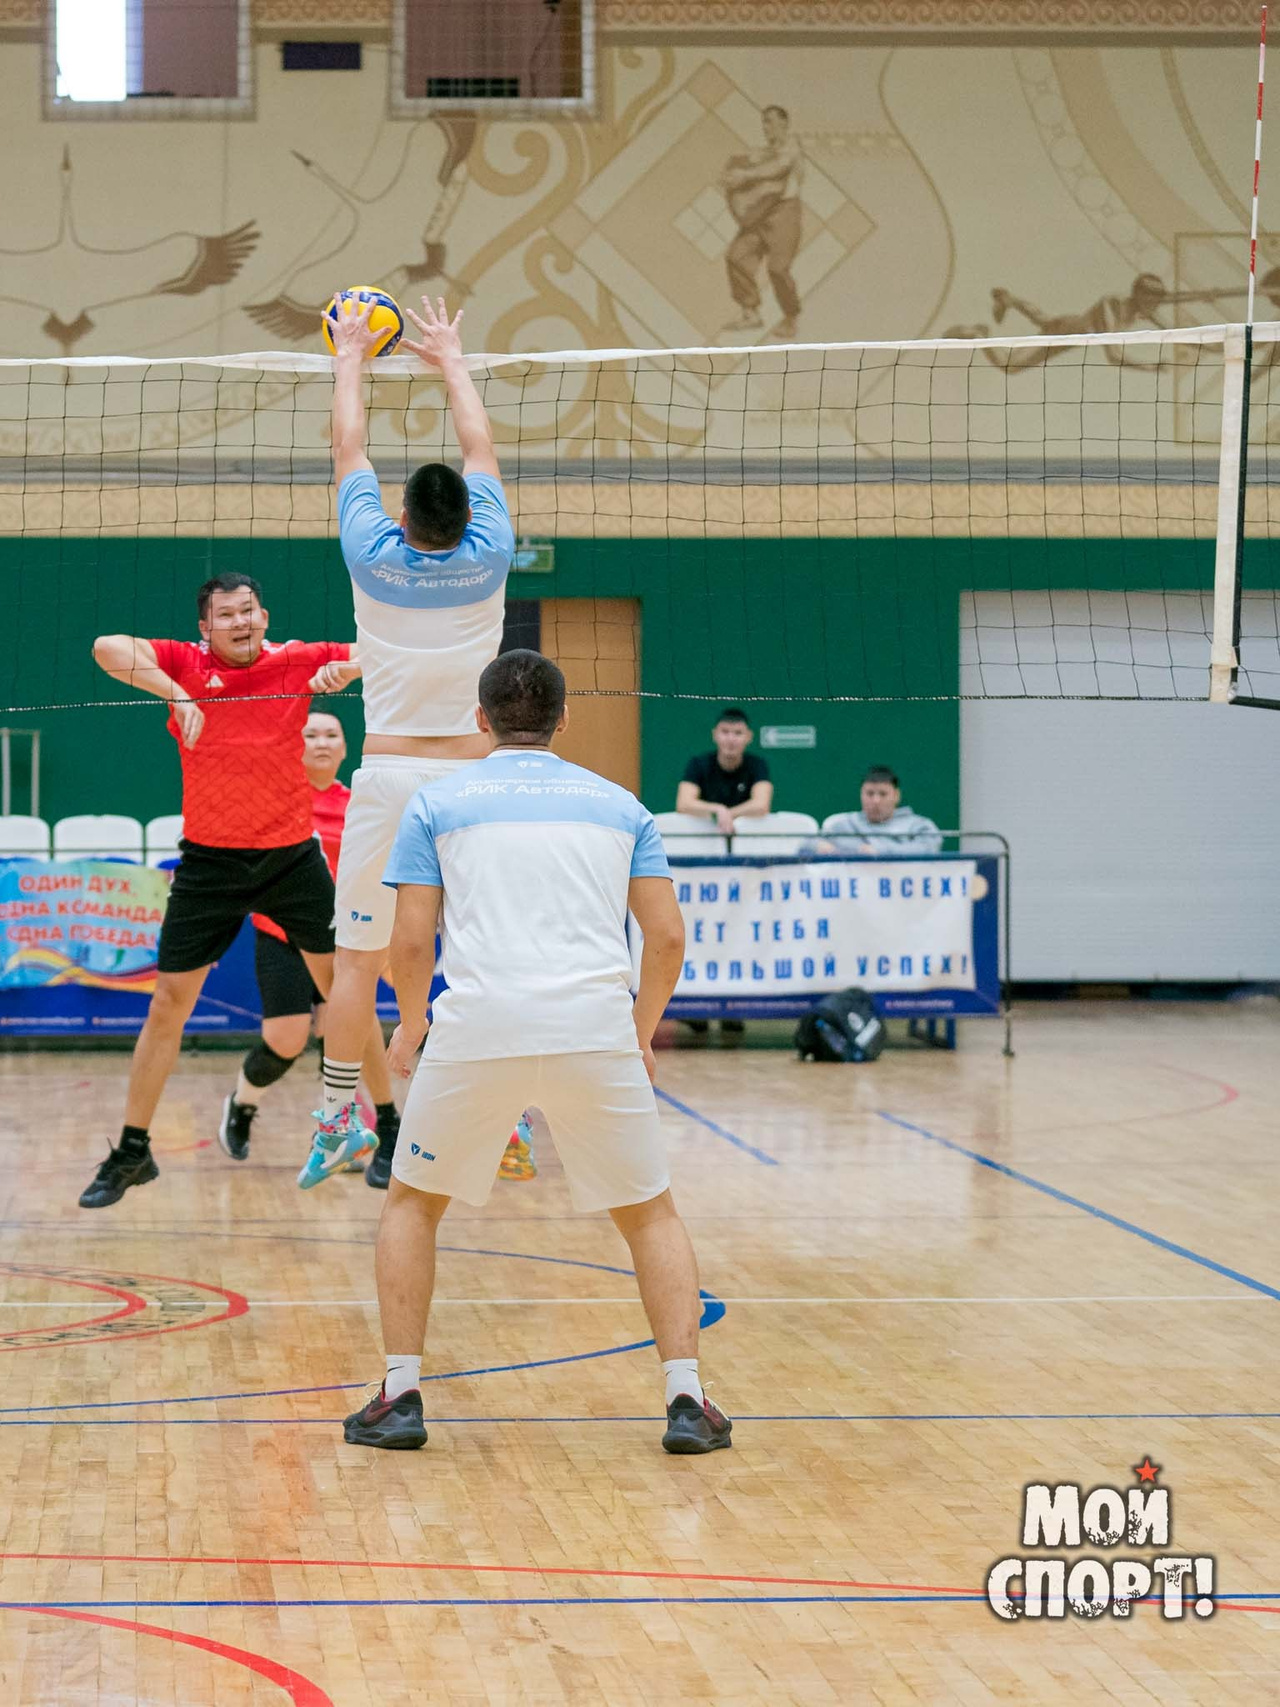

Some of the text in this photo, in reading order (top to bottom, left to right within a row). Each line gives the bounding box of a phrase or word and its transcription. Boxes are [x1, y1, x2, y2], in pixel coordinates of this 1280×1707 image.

[19, 874, 83, 893] ОДИН
[760, 876, 859, 902] ЛУЧШЕ
[879, 876, 968, 899] ВСЕХ!
[7, 923, 156, 948] ОДНА ПОБЕДА!
[751, 917, 830, 943] ТЕБЯ
[683, 953, 968, 982] БОЛЬШОЙ УСПЕХ!
